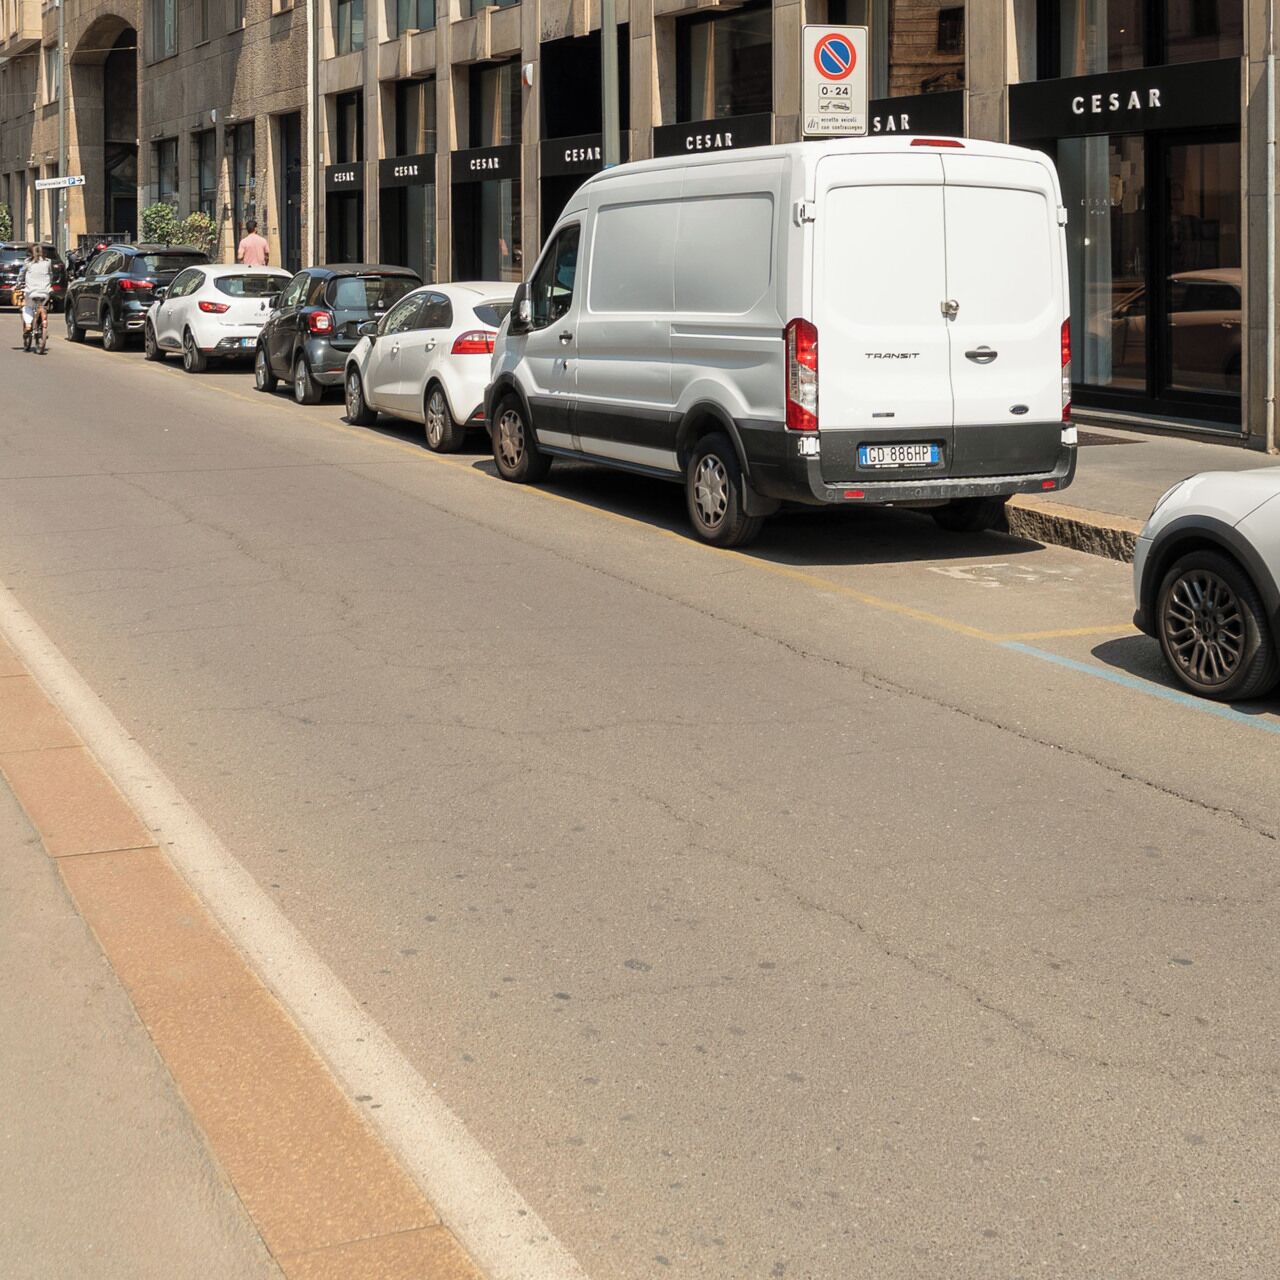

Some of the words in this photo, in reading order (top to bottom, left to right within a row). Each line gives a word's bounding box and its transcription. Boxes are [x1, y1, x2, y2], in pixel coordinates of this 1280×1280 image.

[1072, 88, 1161, 115] CESAR
[873, 113, 910, 132] SAR
[686, 132, 733, 150] CESAR
[565, 147, 601, 162] CESAR
[394, 165, 418, 176] CESAR
[470, 157, 499, 170] CESAR
[334, 171, 354, 182] CESAR
[869, 447, 885, 462] GD
[890, 445, 929, 461] 886HP
